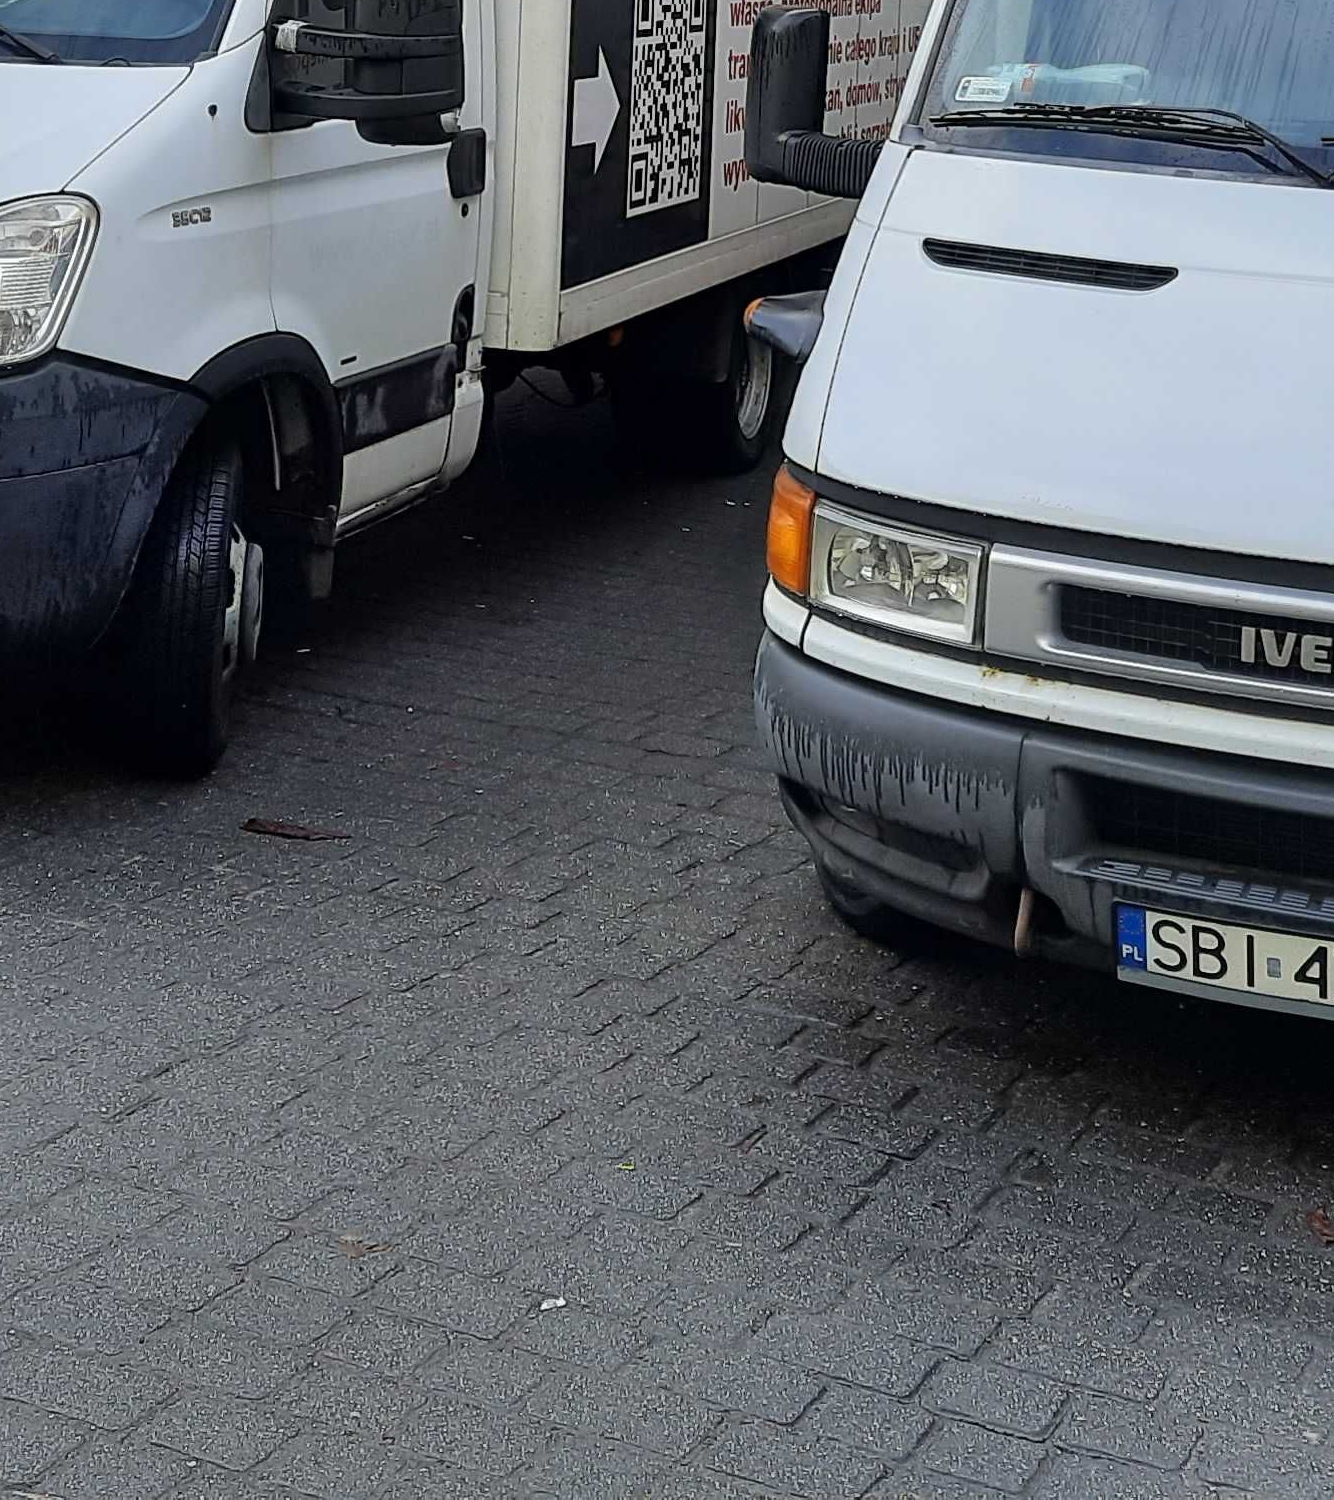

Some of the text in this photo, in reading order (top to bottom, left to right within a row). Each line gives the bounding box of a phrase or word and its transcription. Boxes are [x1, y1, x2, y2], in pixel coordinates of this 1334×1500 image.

[845, 34, 875, 65] całego
[878, 29, 899, 61] kraju
[847, 75, 882, 108] domów,
[1121, 944, 1144, 963] PL
[1151, 918, 1256, 988] SBI
